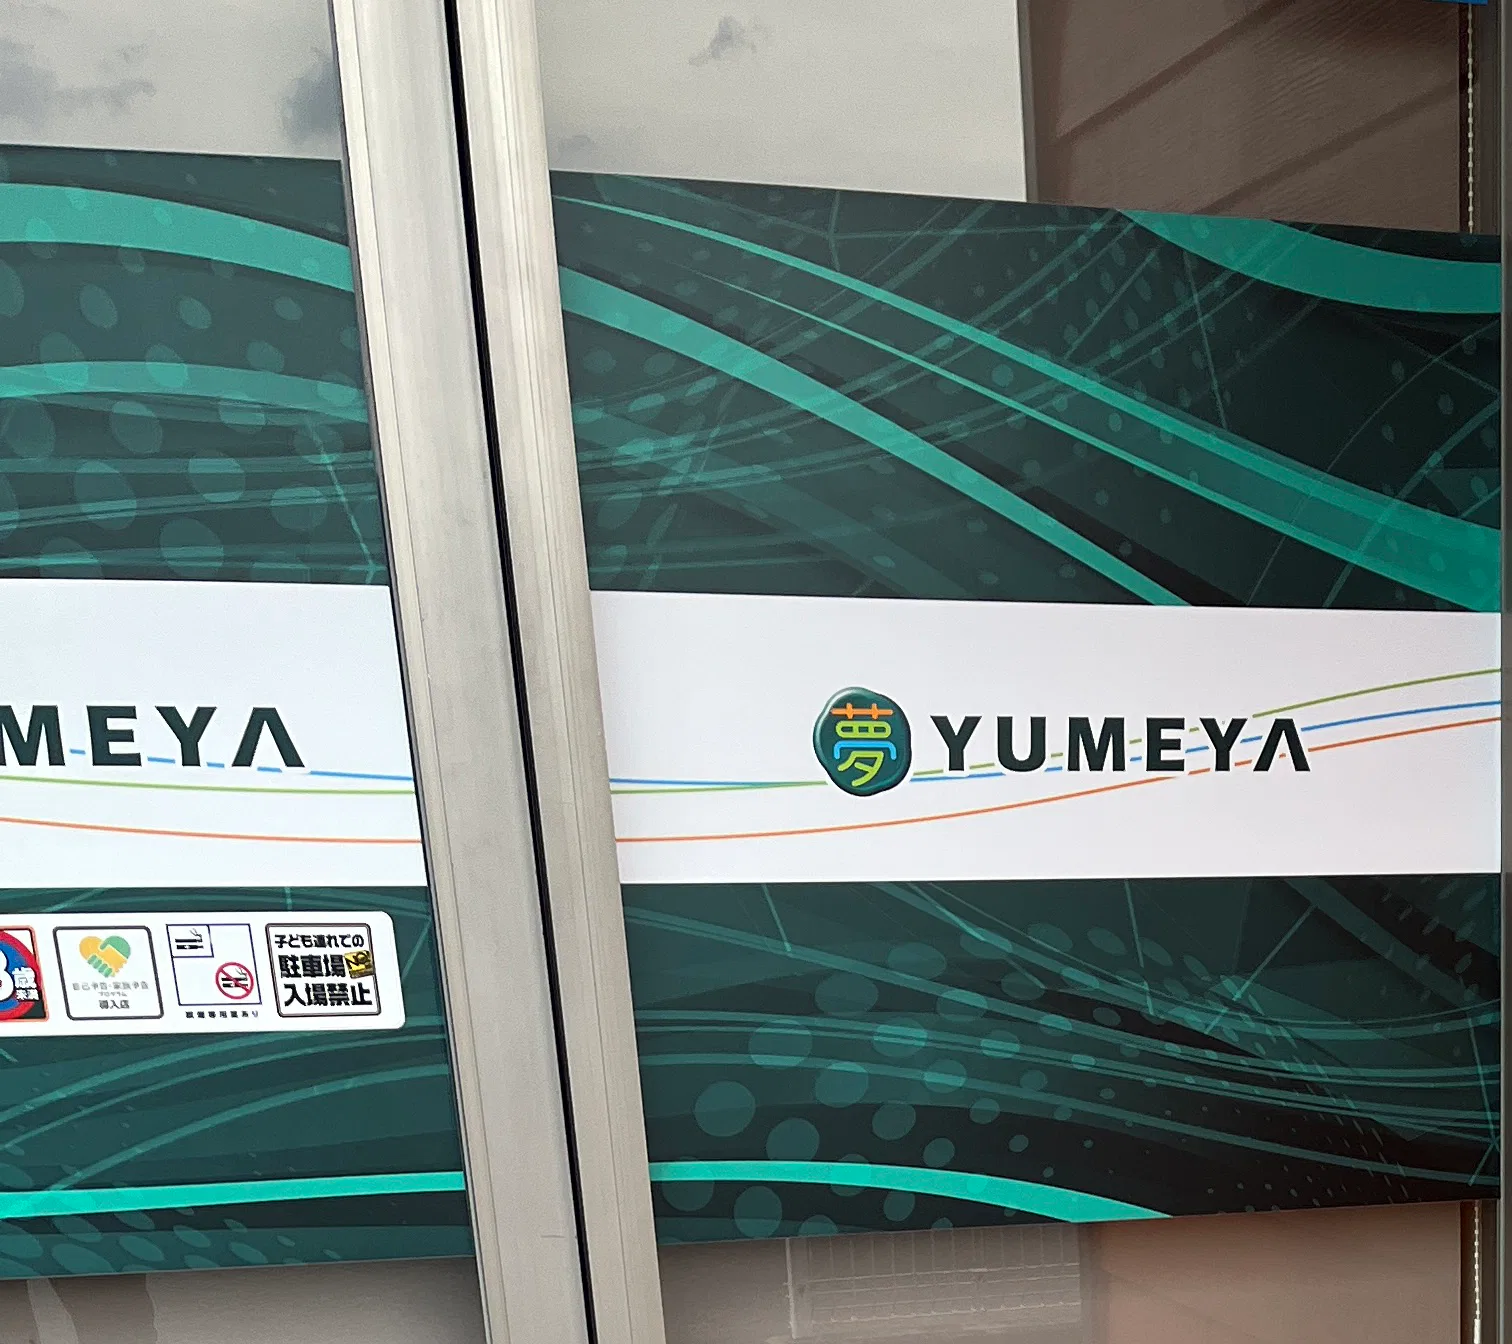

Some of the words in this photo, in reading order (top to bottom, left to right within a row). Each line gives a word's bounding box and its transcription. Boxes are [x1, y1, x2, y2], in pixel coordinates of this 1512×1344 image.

[930, 715, 1311, 772] YUMEYA
[274, 933, 365, 948] 子ども連れでの
[278, 953, 346, 978] 駐車場
[283, 981, 373, 1006] 入場禁止
